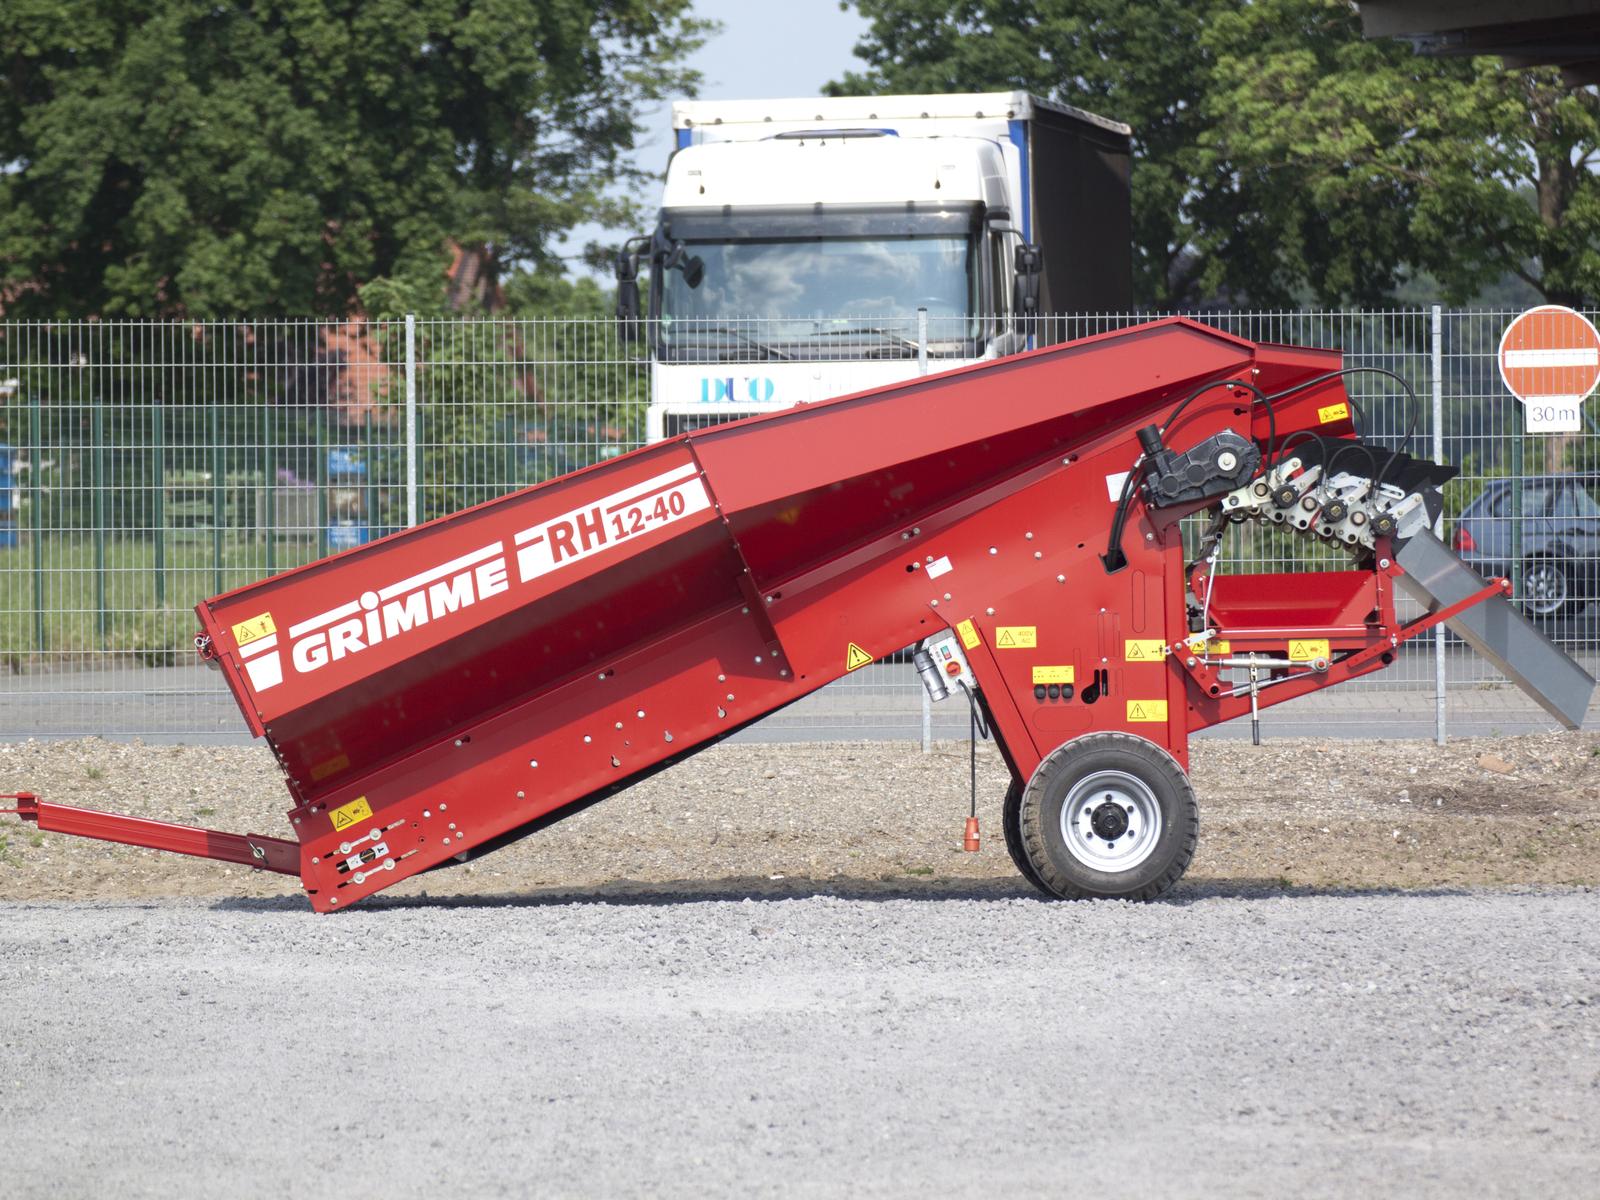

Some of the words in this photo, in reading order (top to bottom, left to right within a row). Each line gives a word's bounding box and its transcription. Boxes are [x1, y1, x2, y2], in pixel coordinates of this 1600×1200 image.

[701, 377, 775, 402] DUO
[546, 508, 608, 564] RH
[612, 490, 686, 541] 12-40
